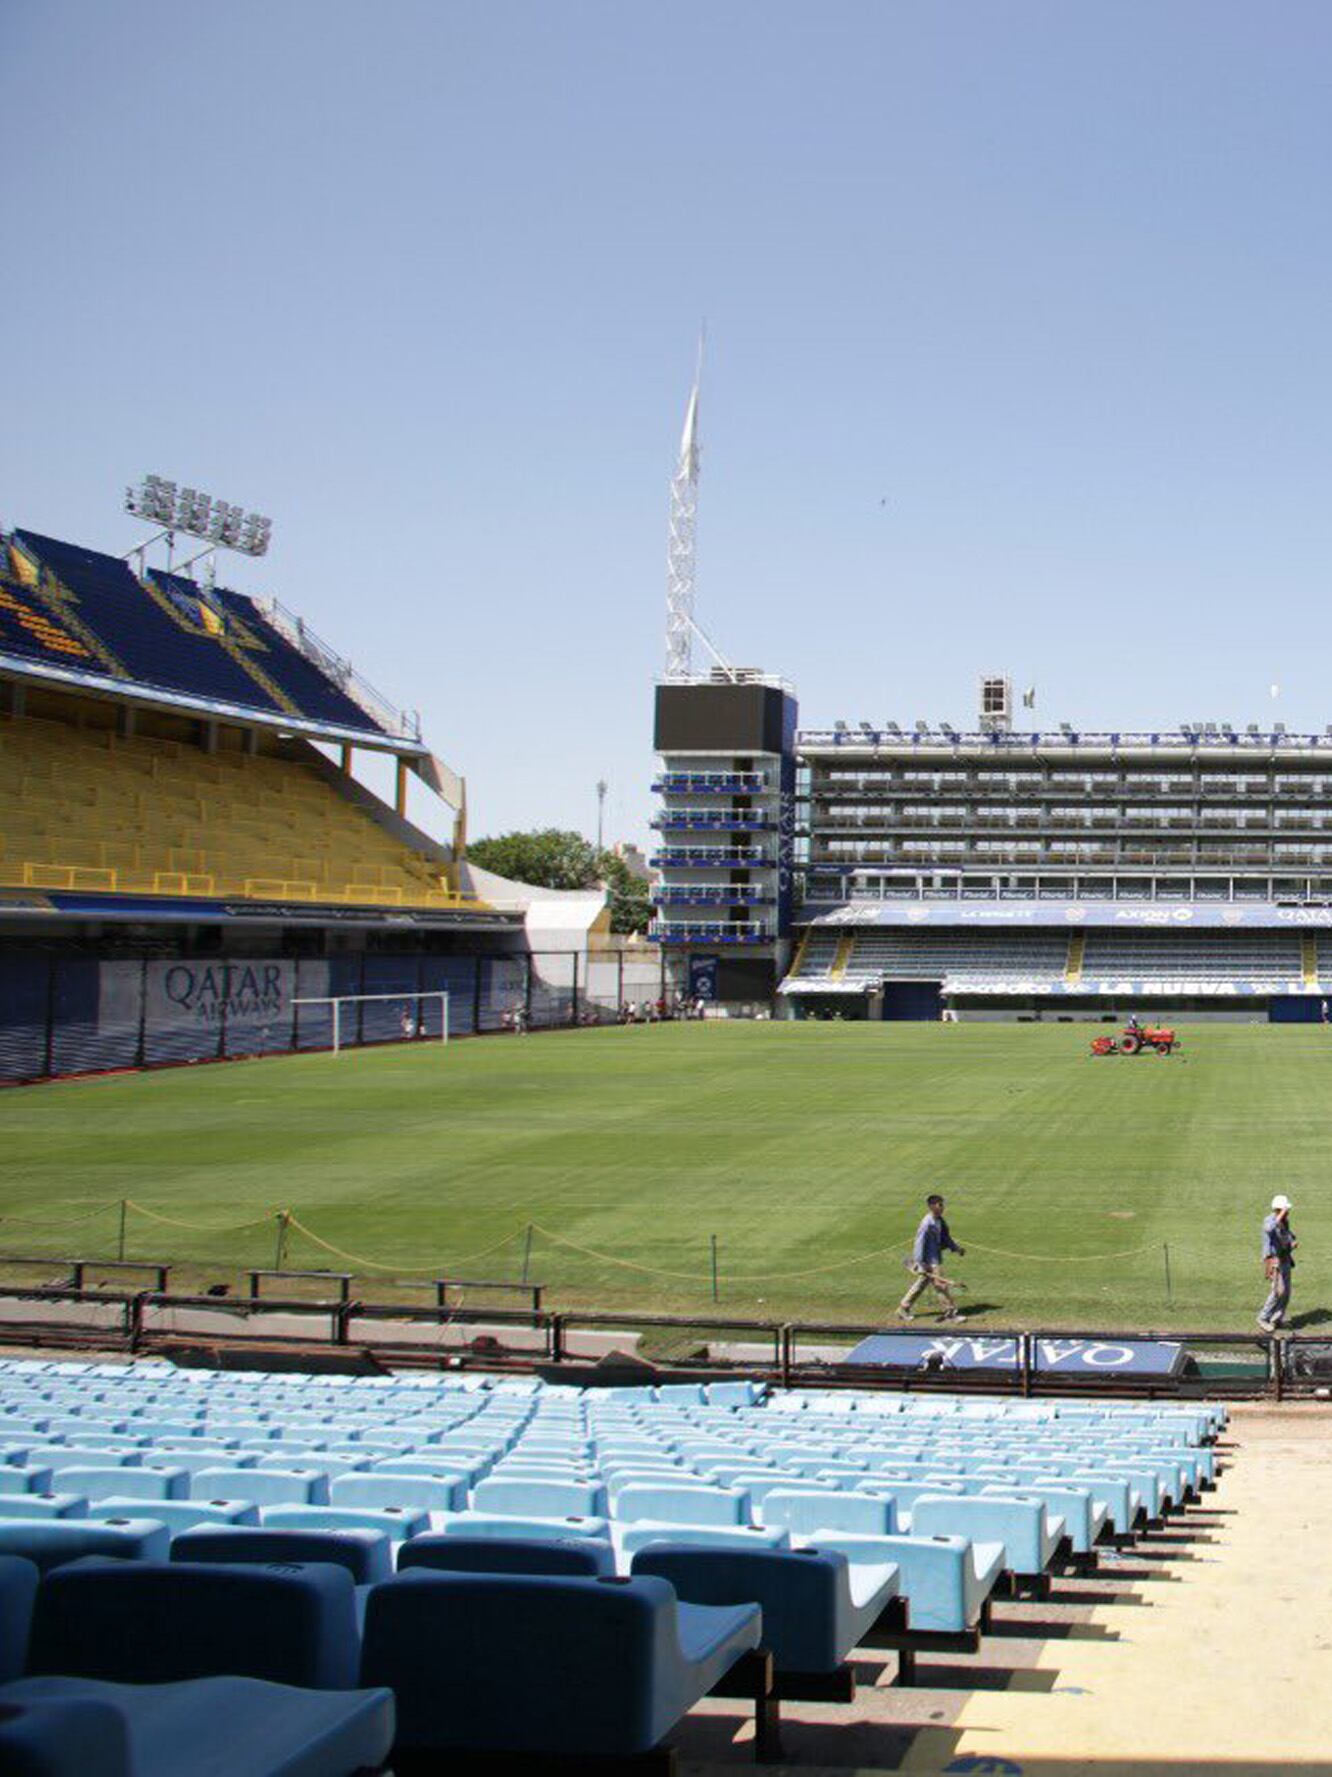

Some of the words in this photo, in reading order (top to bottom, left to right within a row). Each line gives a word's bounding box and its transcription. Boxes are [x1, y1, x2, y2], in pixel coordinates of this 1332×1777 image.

[165, 965, 281, 1009] QATAR
[1098, 983, 1134, 995] LA
[1141, 983, 1236, 995] NUEVA
[1287, 983, 1323, 995] LA
